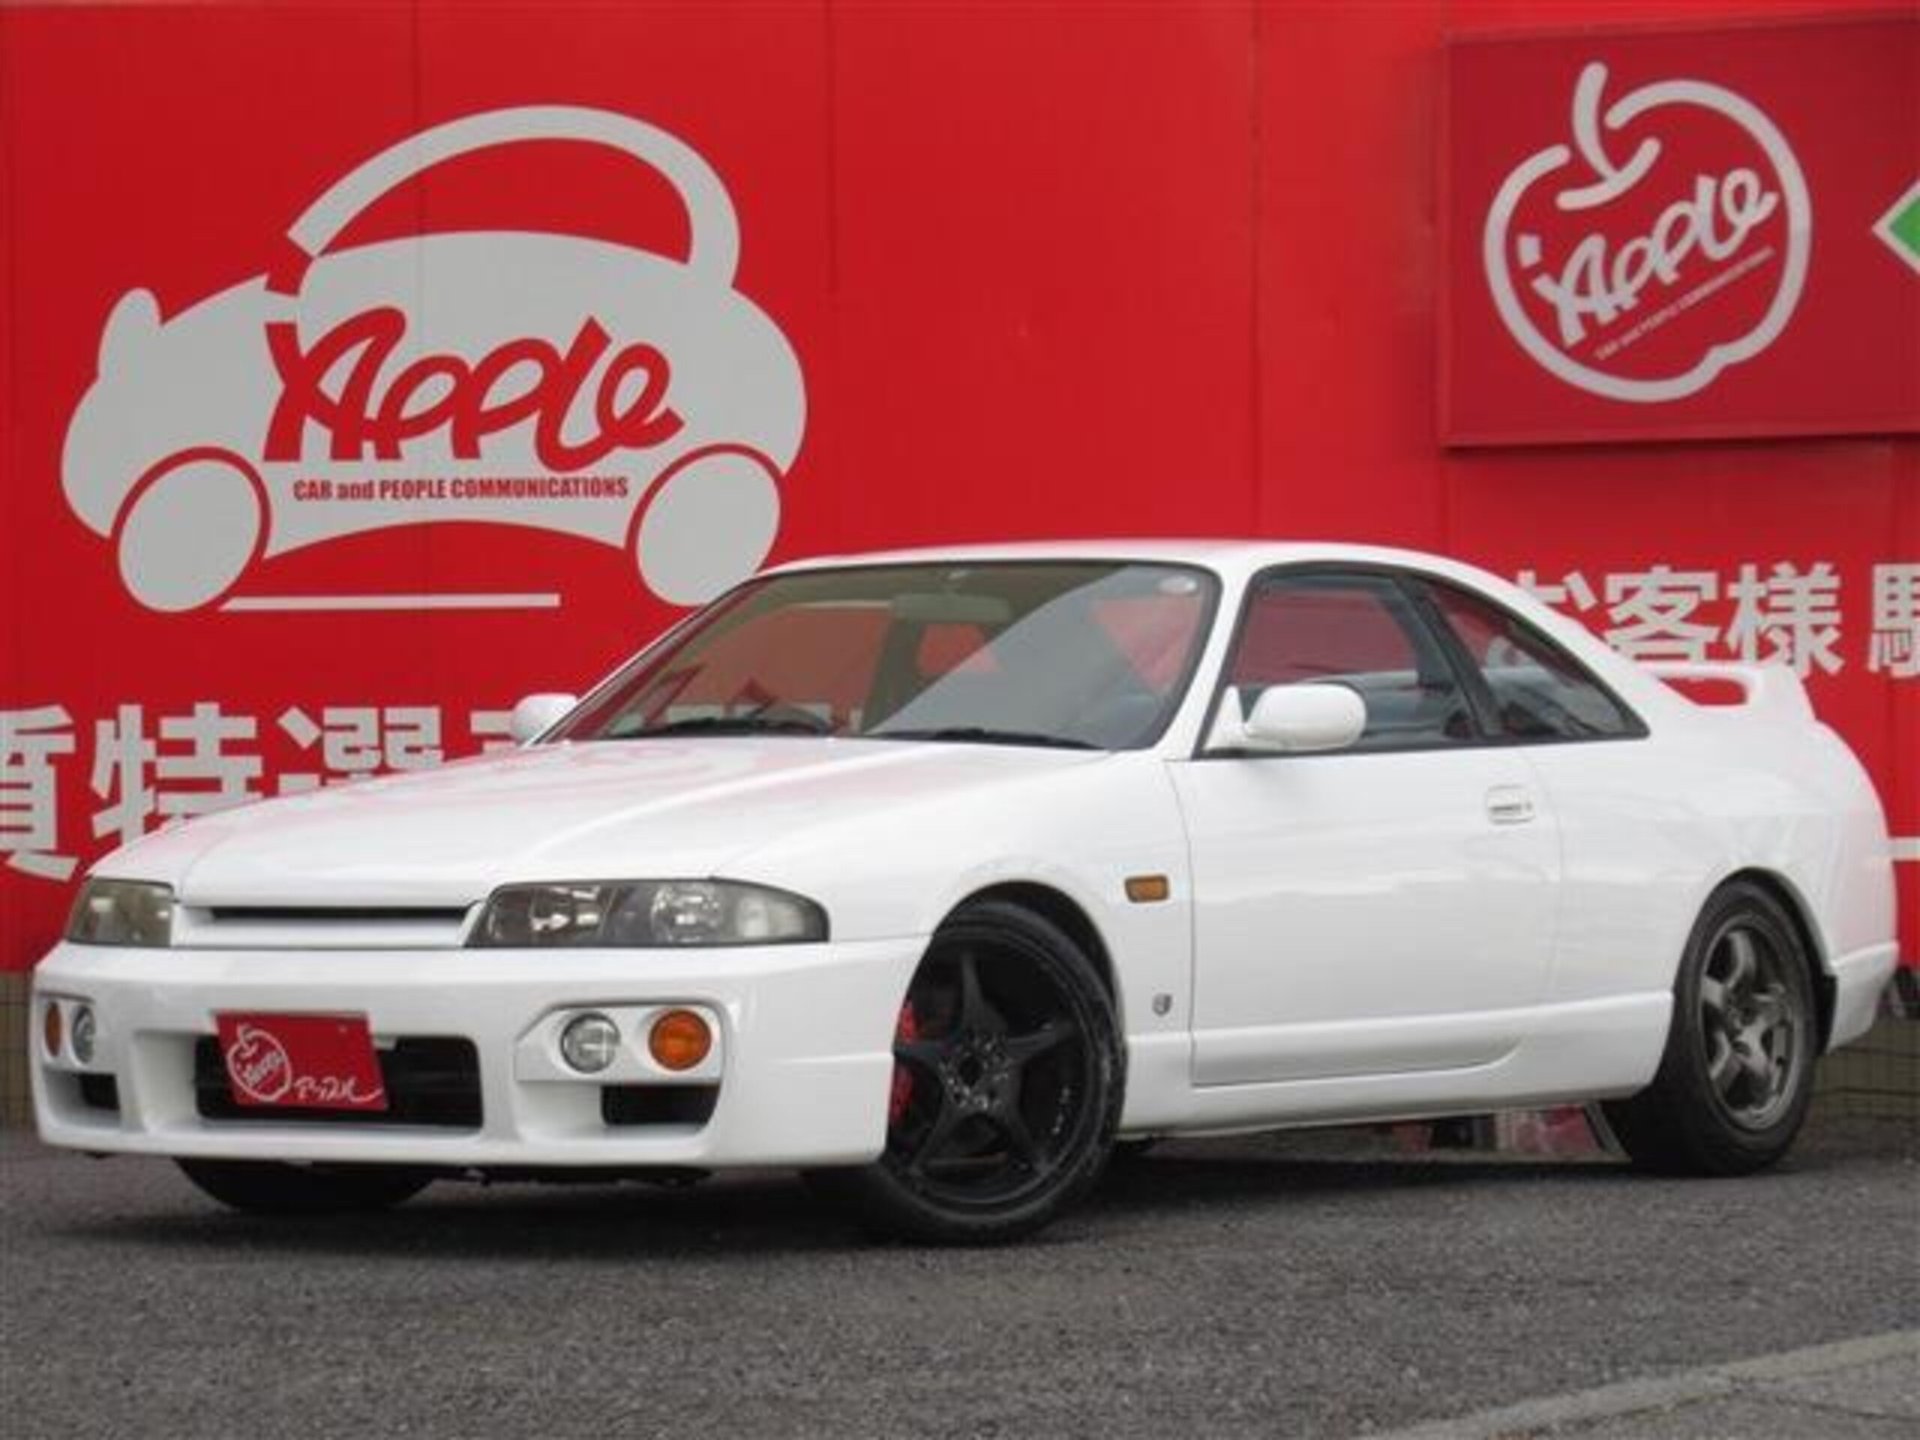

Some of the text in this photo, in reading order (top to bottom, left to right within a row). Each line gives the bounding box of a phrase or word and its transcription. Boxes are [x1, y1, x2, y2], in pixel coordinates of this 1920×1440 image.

[337, 480, 374, 500] and
[379, 478, 447, 500] PEOPLE
[451, 476, 629, 499] COMMUNICATIONS
